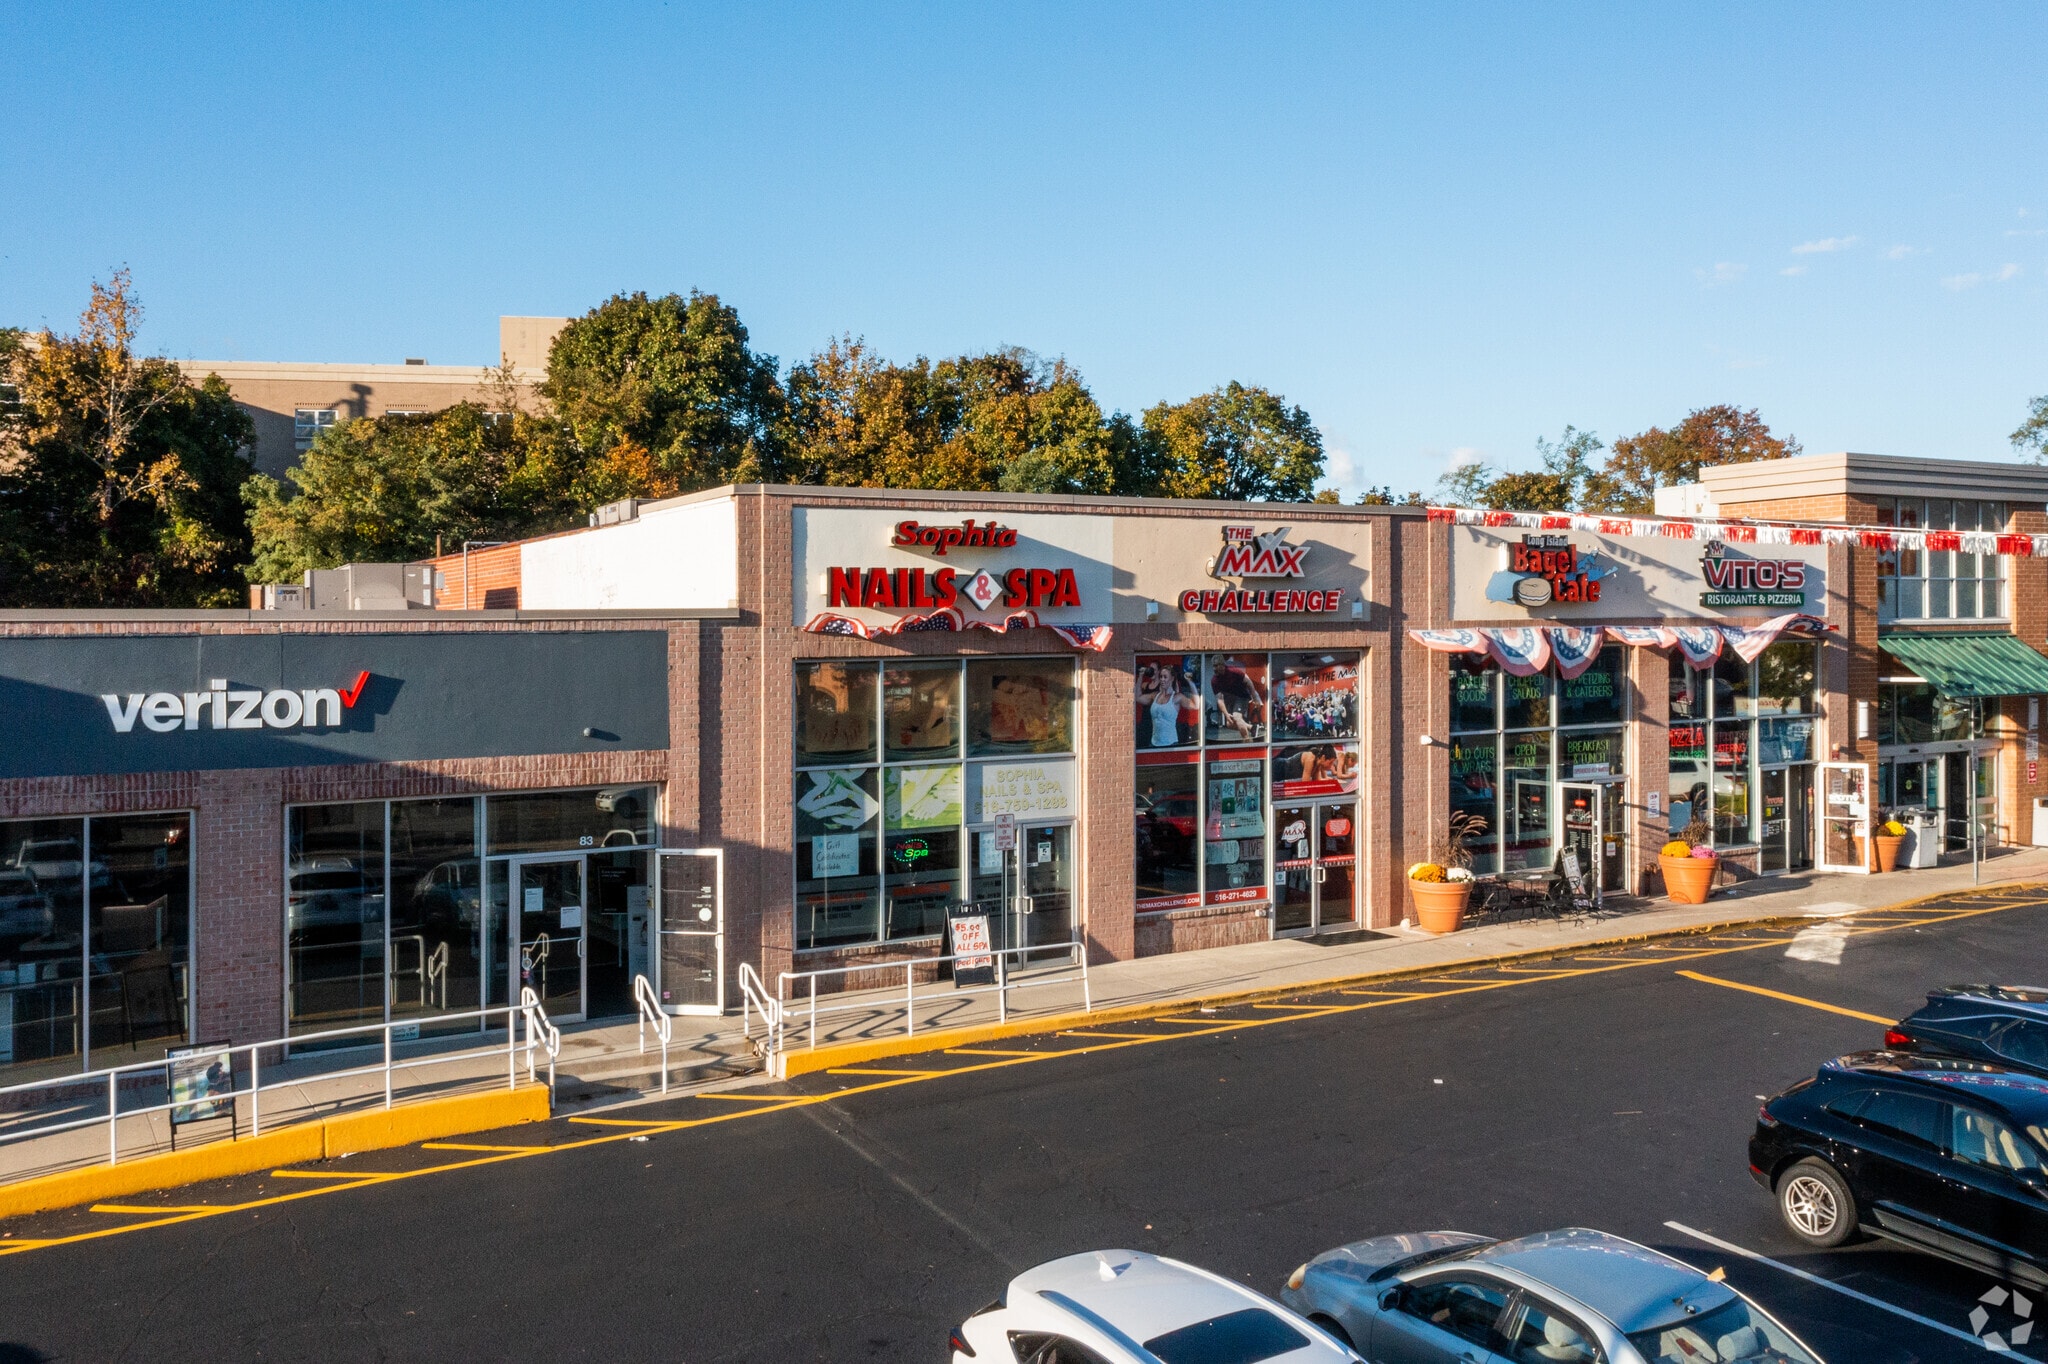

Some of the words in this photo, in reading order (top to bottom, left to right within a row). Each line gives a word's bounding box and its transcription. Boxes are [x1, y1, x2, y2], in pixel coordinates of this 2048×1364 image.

[893, 519, 1018, 556] Sophia
[1226, 527, 1253, 540] THE
[1527, 534, 1545, 548] Long
[1546, 536, 1568, 547] Island
[1220, 547, 1305, 575] MAX
[1513, 543, 1577, 580] Bagel
[1704, 559, 1805, 589] VITO'S
[827, 566, 958, 608] NAILS
[974, 574, 992, 601] &
[1004, 567, 1081, 608] SPA
[1553, 571, 1601, 602] Cafe
[1182, 589, 1340, 612] CHALLENGE
[1707, 593, 1757, 605] RISTORANTE
[1758, 594, 1766, 605] &
[1767, 593, 1802, 605] PIZZERIA
[1322, 670, 1336, 682] THE
[1456, 689, 1487, 702] GOODS
[1512, 687, 1541, 700] SALADS
[1574, 685, 1613, 698] CATERERS
[101, 678, 341, 733] verizon
[1669, 727, 1705, 747] IZZA
[1514, 744, 1537, 757] OPEN
[1567, 739, 1609, 753] BREAKFAST
[1473, 746, 1495, 760] CUTS
[1783, 749, 1792, 759] 91
[1523, 757, 1537, 768] AM
[996, 767, 1045, 783] SOPHIA
[981, 783, 1018, 799] NAILS
[1022, 782, 1031, 796] &
[1036, 780, 1062, 795] SPA
[1283, 827, 1304, 836] MAX
[579, 835, 594, 846] 83
[904, 848, 929, 860] Spa
[1136, 897, 1200, 909] THEMAXCHALLENGE.COM
[955, 923, 980, 931] $5.00
[962, 932, 979, 941] OFF
[957, 943, 971, 952] ALL
[973, 941, 988, 951] SPA
